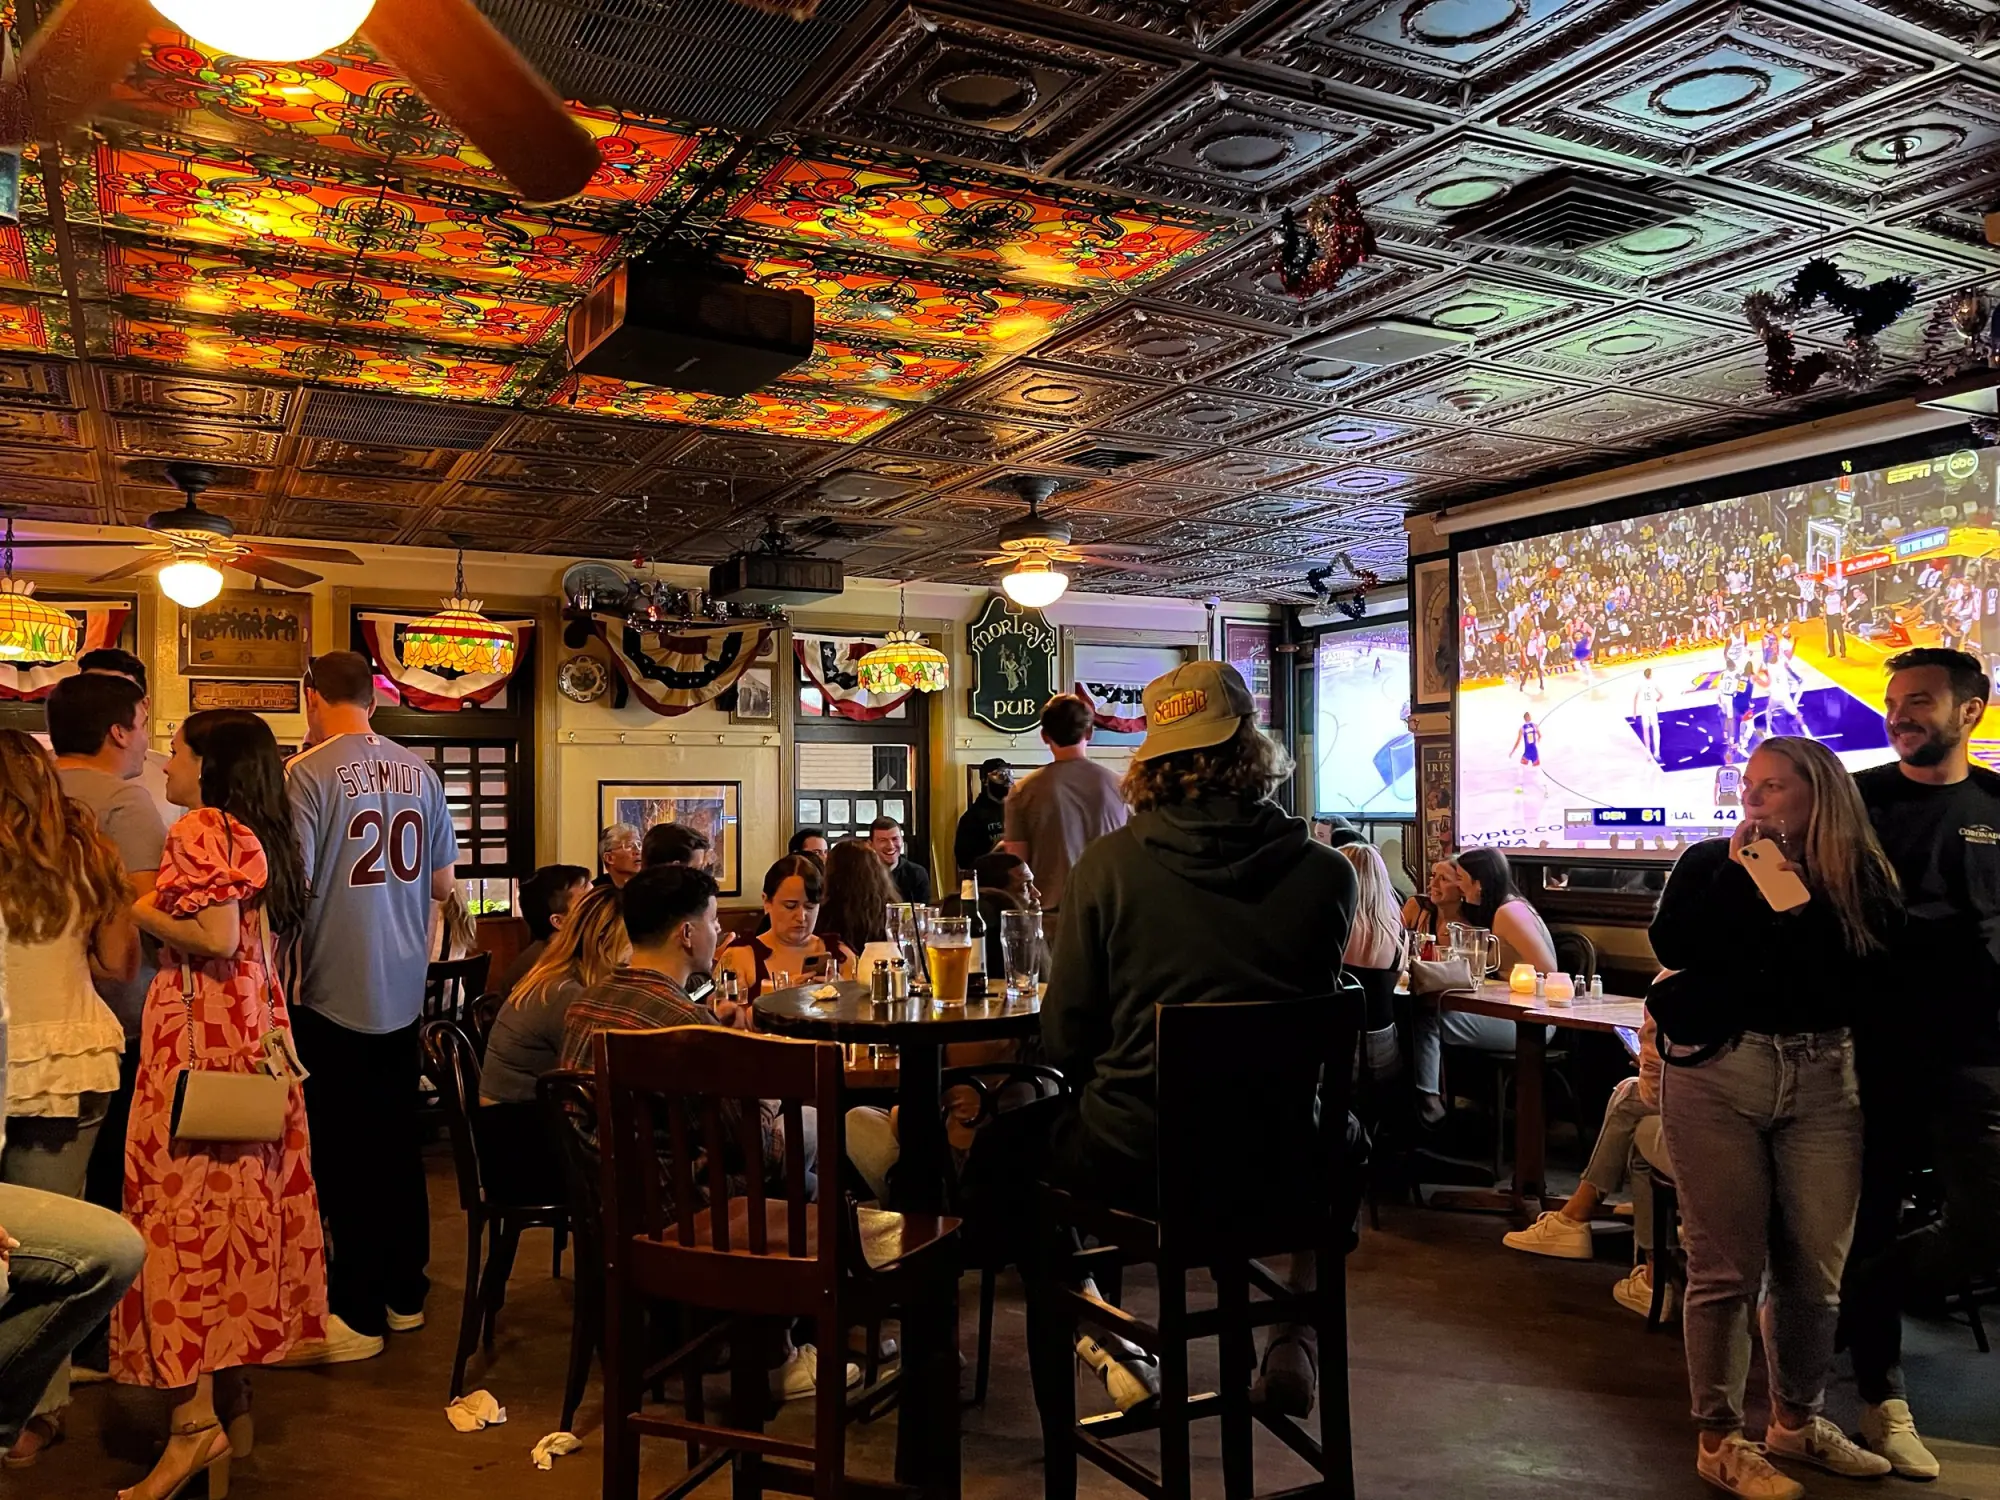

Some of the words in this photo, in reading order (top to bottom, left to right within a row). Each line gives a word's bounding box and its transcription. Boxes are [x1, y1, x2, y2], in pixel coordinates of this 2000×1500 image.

[1154, 688, 1208, 723] Seinfeld
[335, 759, 423, 799] SCHMIDT
[1427, 763, 1450, 772] IRIS
[1674, 812, 1696, 820] LAL
[1713, 809, 1738, 821] 44
[1461, 824, 1563, 842] rypto.co
[348, 808, 424, 888] 20
